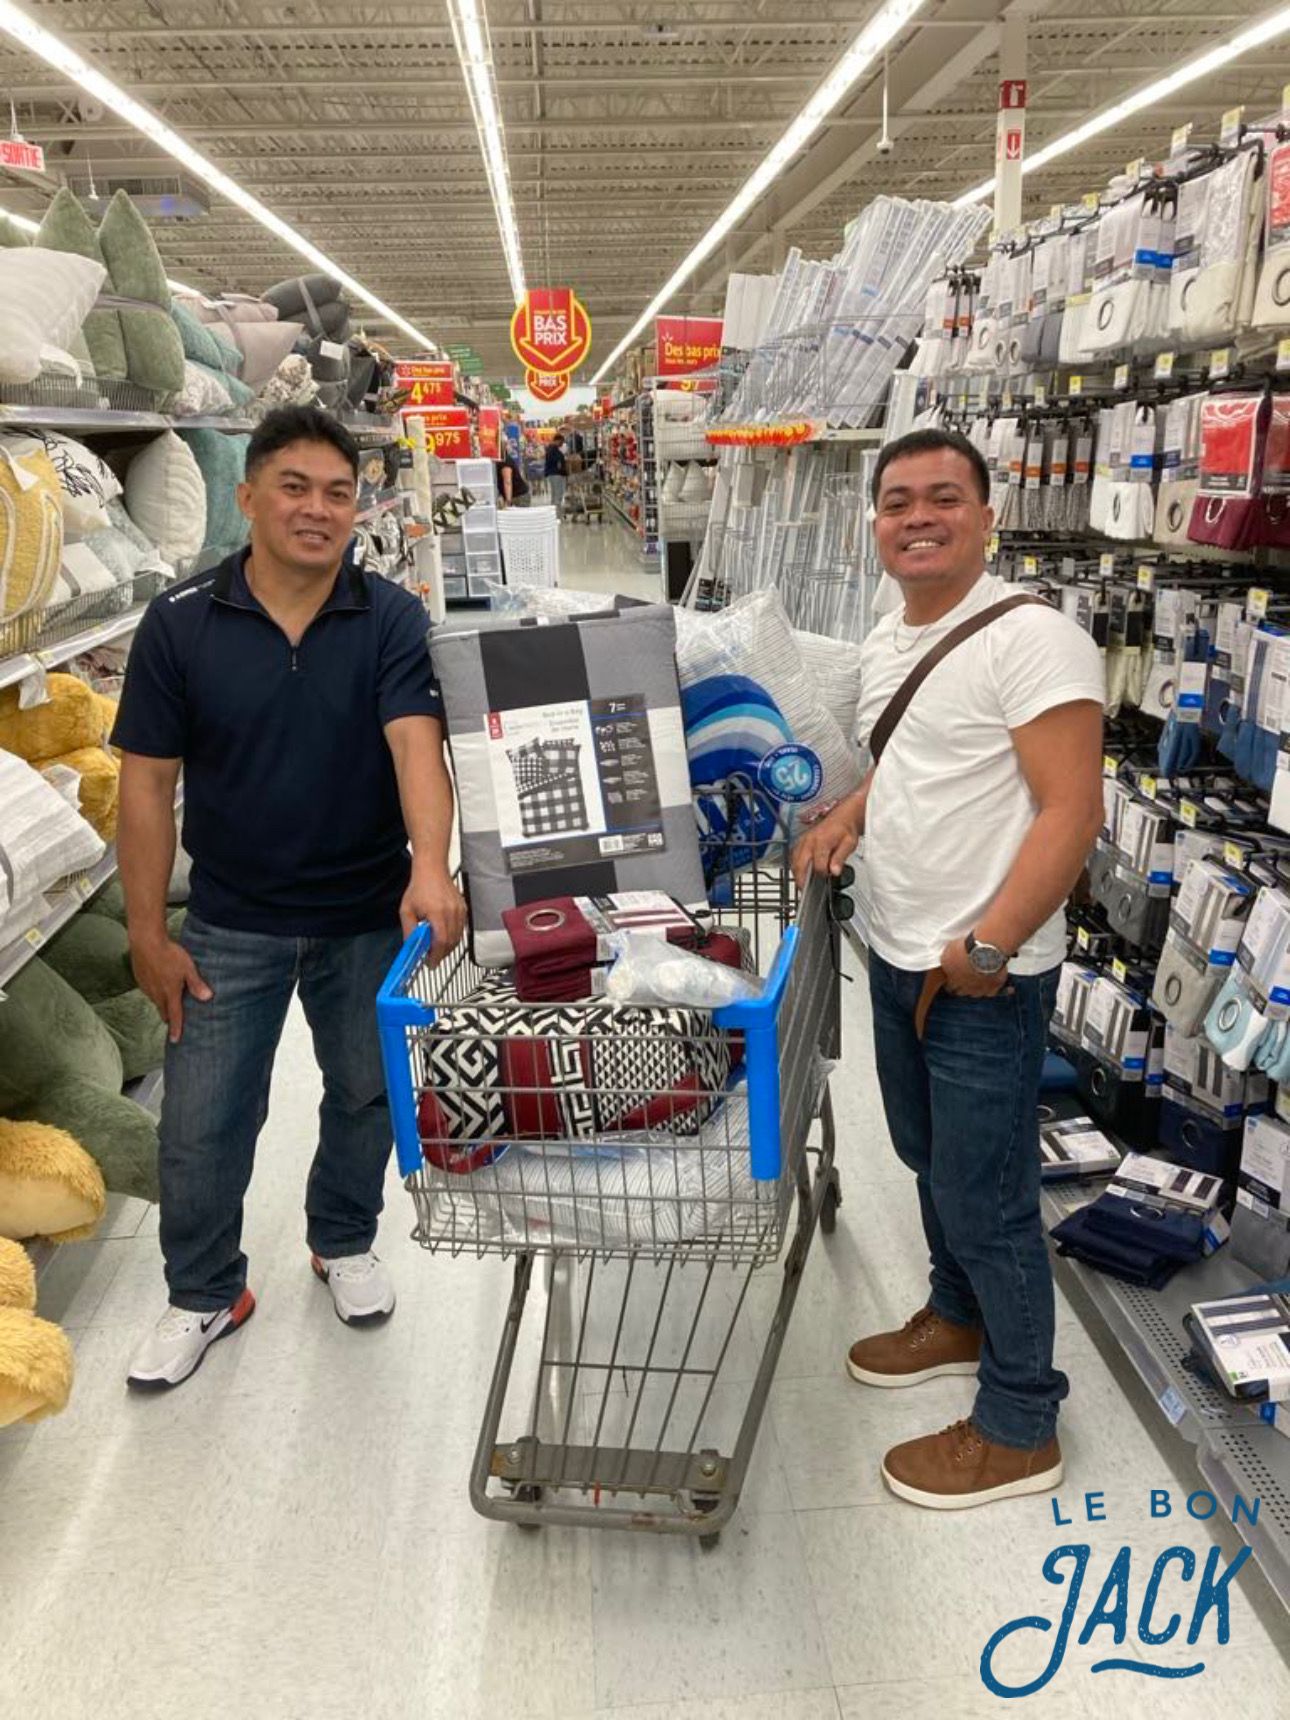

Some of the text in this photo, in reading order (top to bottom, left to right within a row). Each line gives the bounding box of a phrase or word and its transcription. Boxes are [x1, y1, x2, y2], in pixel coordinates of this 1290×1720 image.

[3, 143, 41, 168] SORTIE
[533, 315, 567, 331] BAS
[534, 332, 568, 345] PRIX
